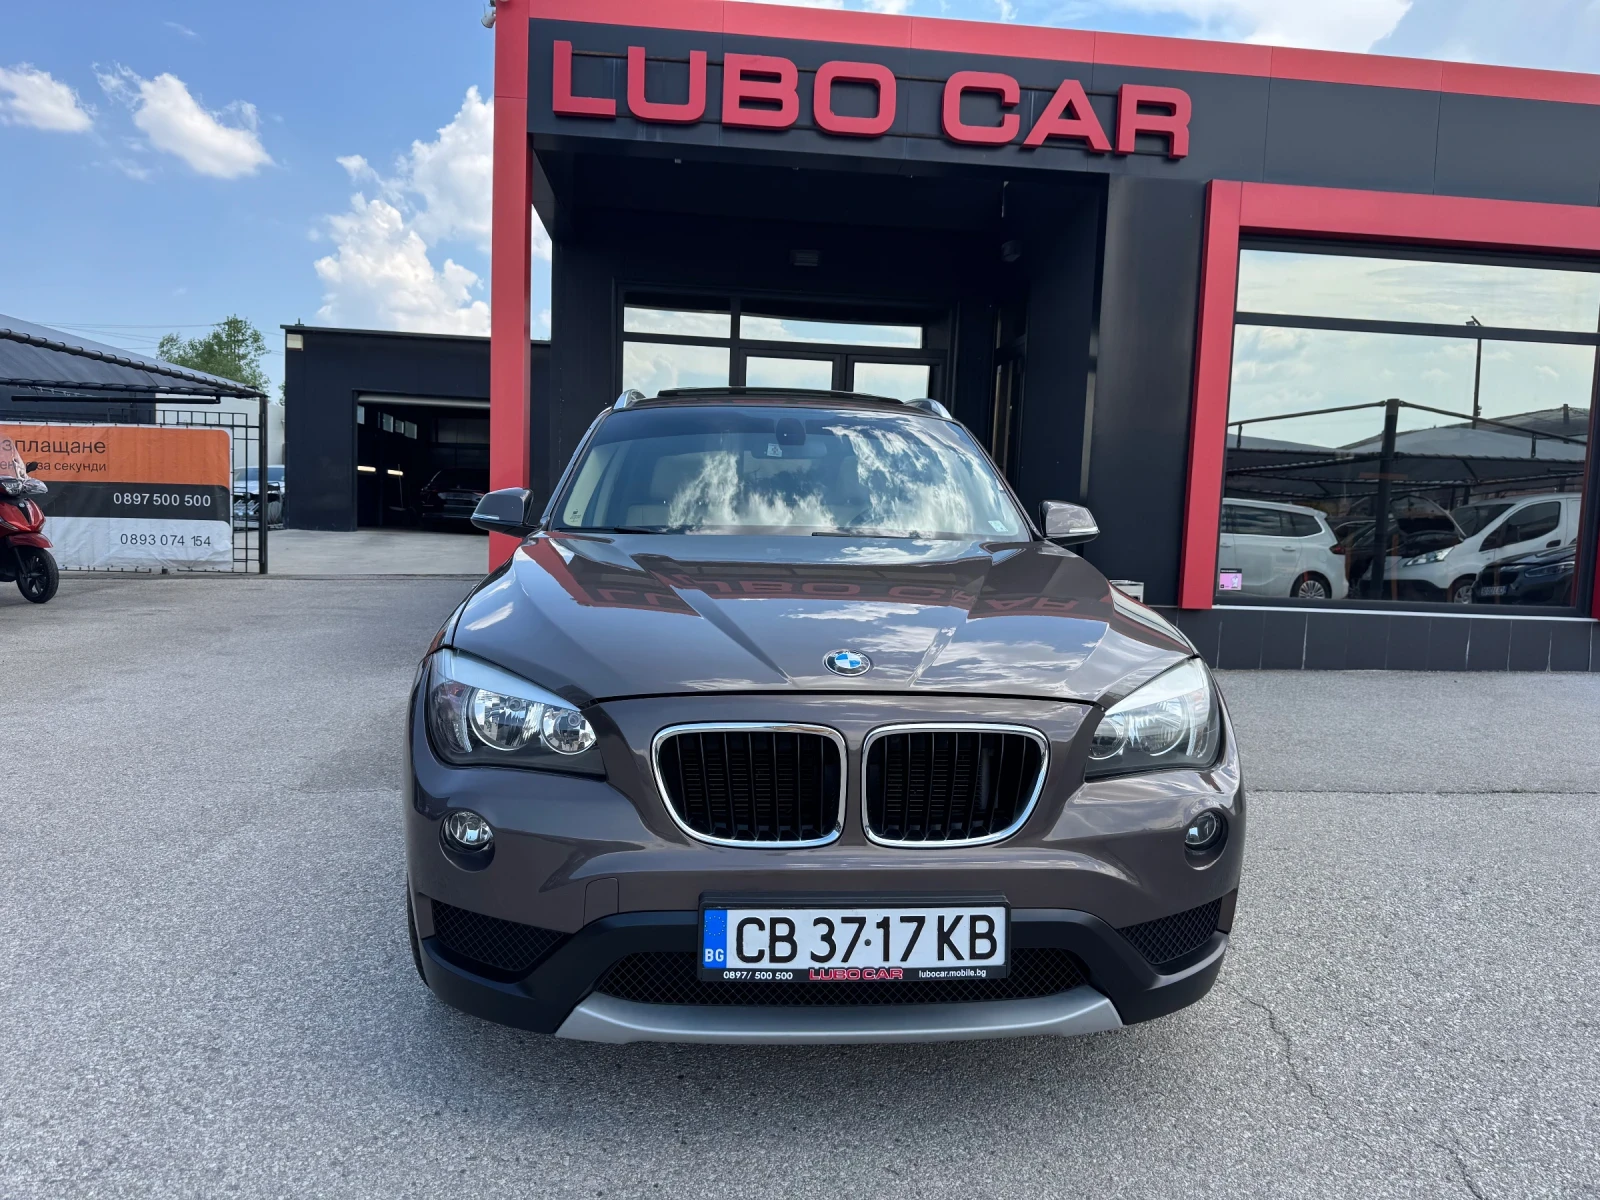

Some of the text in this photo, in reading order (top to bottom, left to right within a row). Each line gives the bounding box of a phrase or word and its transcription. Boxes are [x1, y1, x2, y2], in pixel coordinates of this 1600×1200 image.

[552, 39, 1192, 159] LUBO CAR
[54, 462, 107, 473] секунди
[113, 492, 211, 507] 0897 500 500
[120, 533, 211, 547] 0893 074 154
[736, 916, 798, 964] CB
[936, 914, 998, 961] KB
[704, 949, 725, 962] BG
[723, 971, 793, 980] 0897/ 500 500
[809, 968, 904, 981] LUBO CAR
[918, 968, 987, 978] lubocar.mobile.bg
